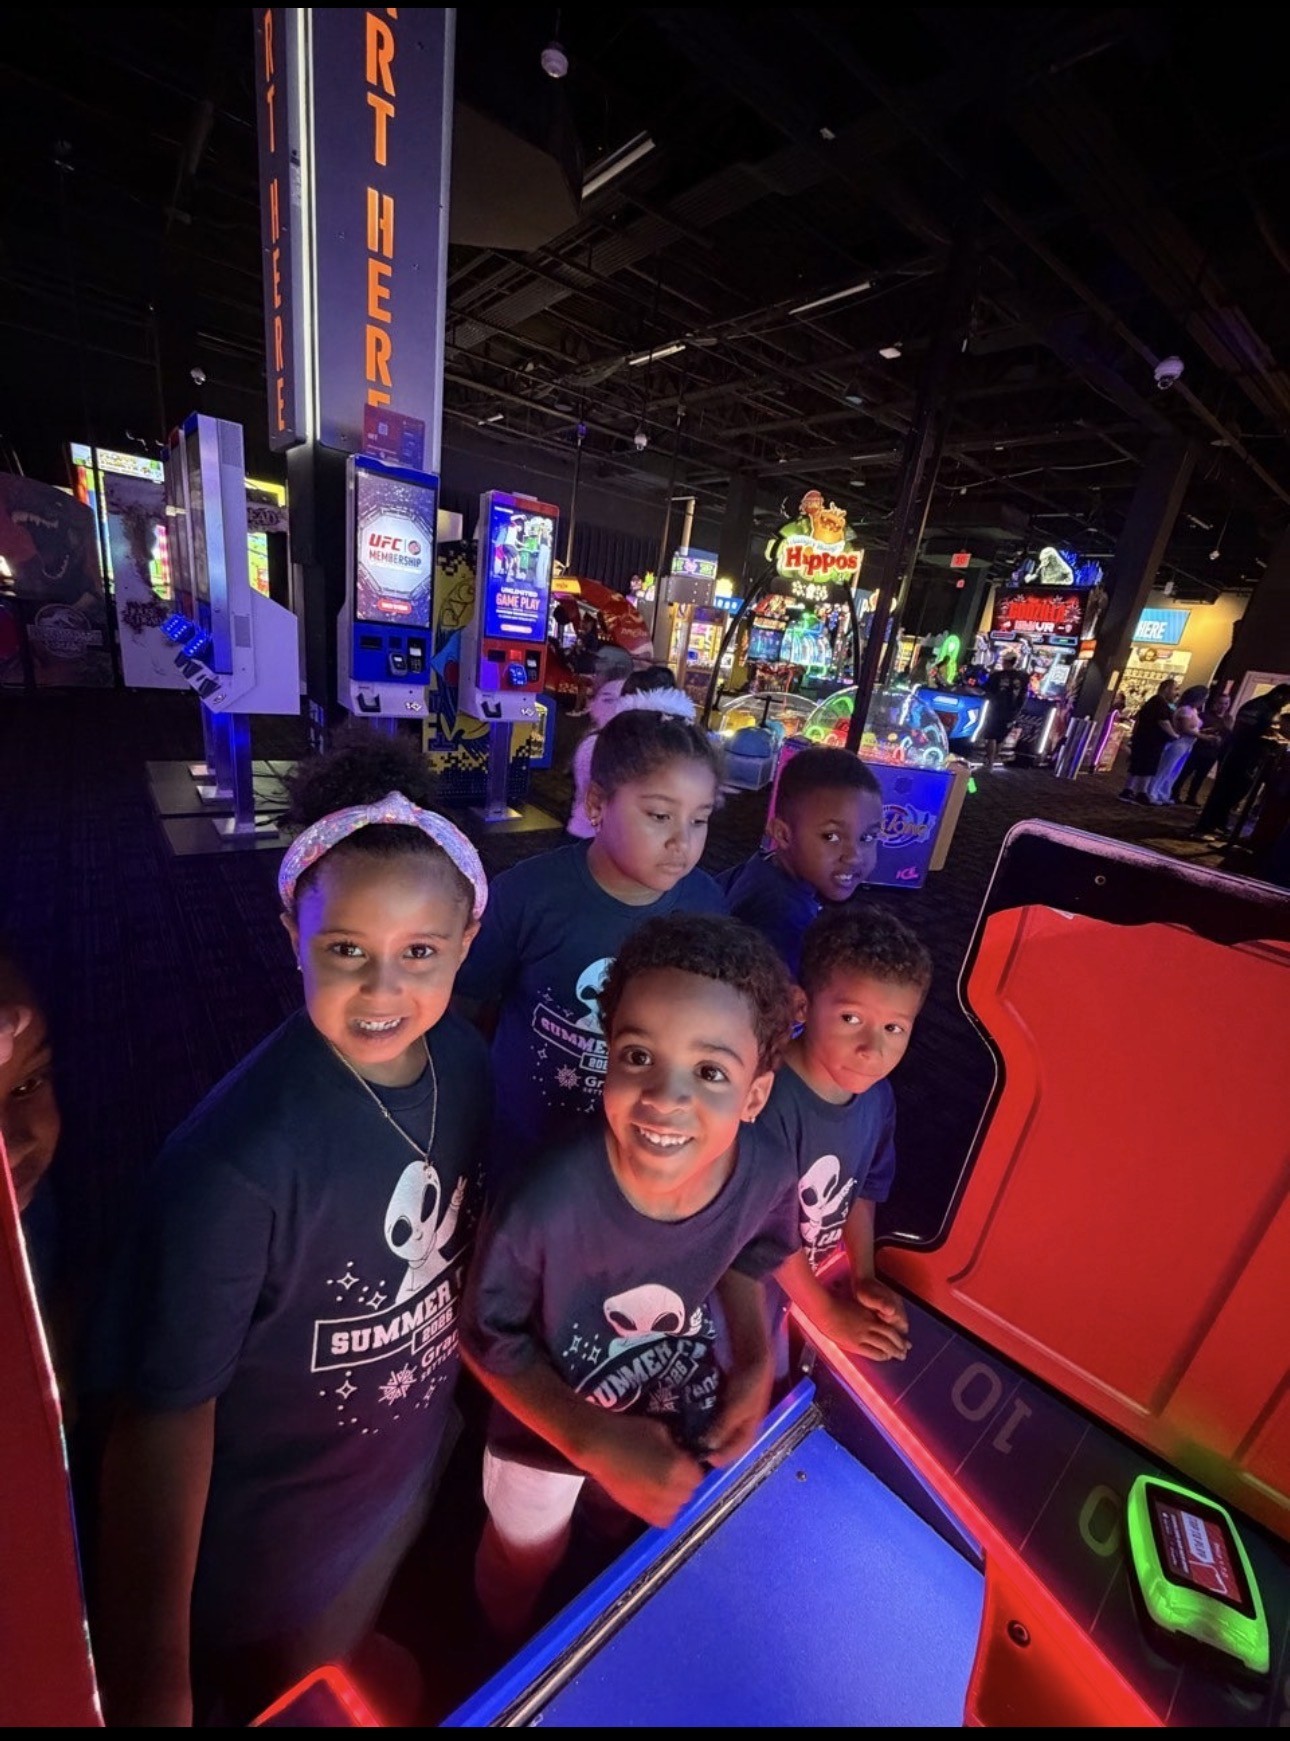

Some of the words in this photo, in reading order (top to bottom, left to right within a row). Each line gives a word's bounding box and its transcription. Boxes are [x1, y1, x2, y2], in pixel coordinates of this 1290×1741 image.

[366, 8, 398, 166] RT
[369, 533, 402, 551] UFC
[369, 549, 422, 568] MEMBERSHIP
[785, 545, 858, 576] Hippos
[495, 592, 519, 609] GAME
[520, 596, 541, 611] PLAY
[541, 1017, 609, 1054] SUMME
[331, 1279, 451, 1355] SUMMER
